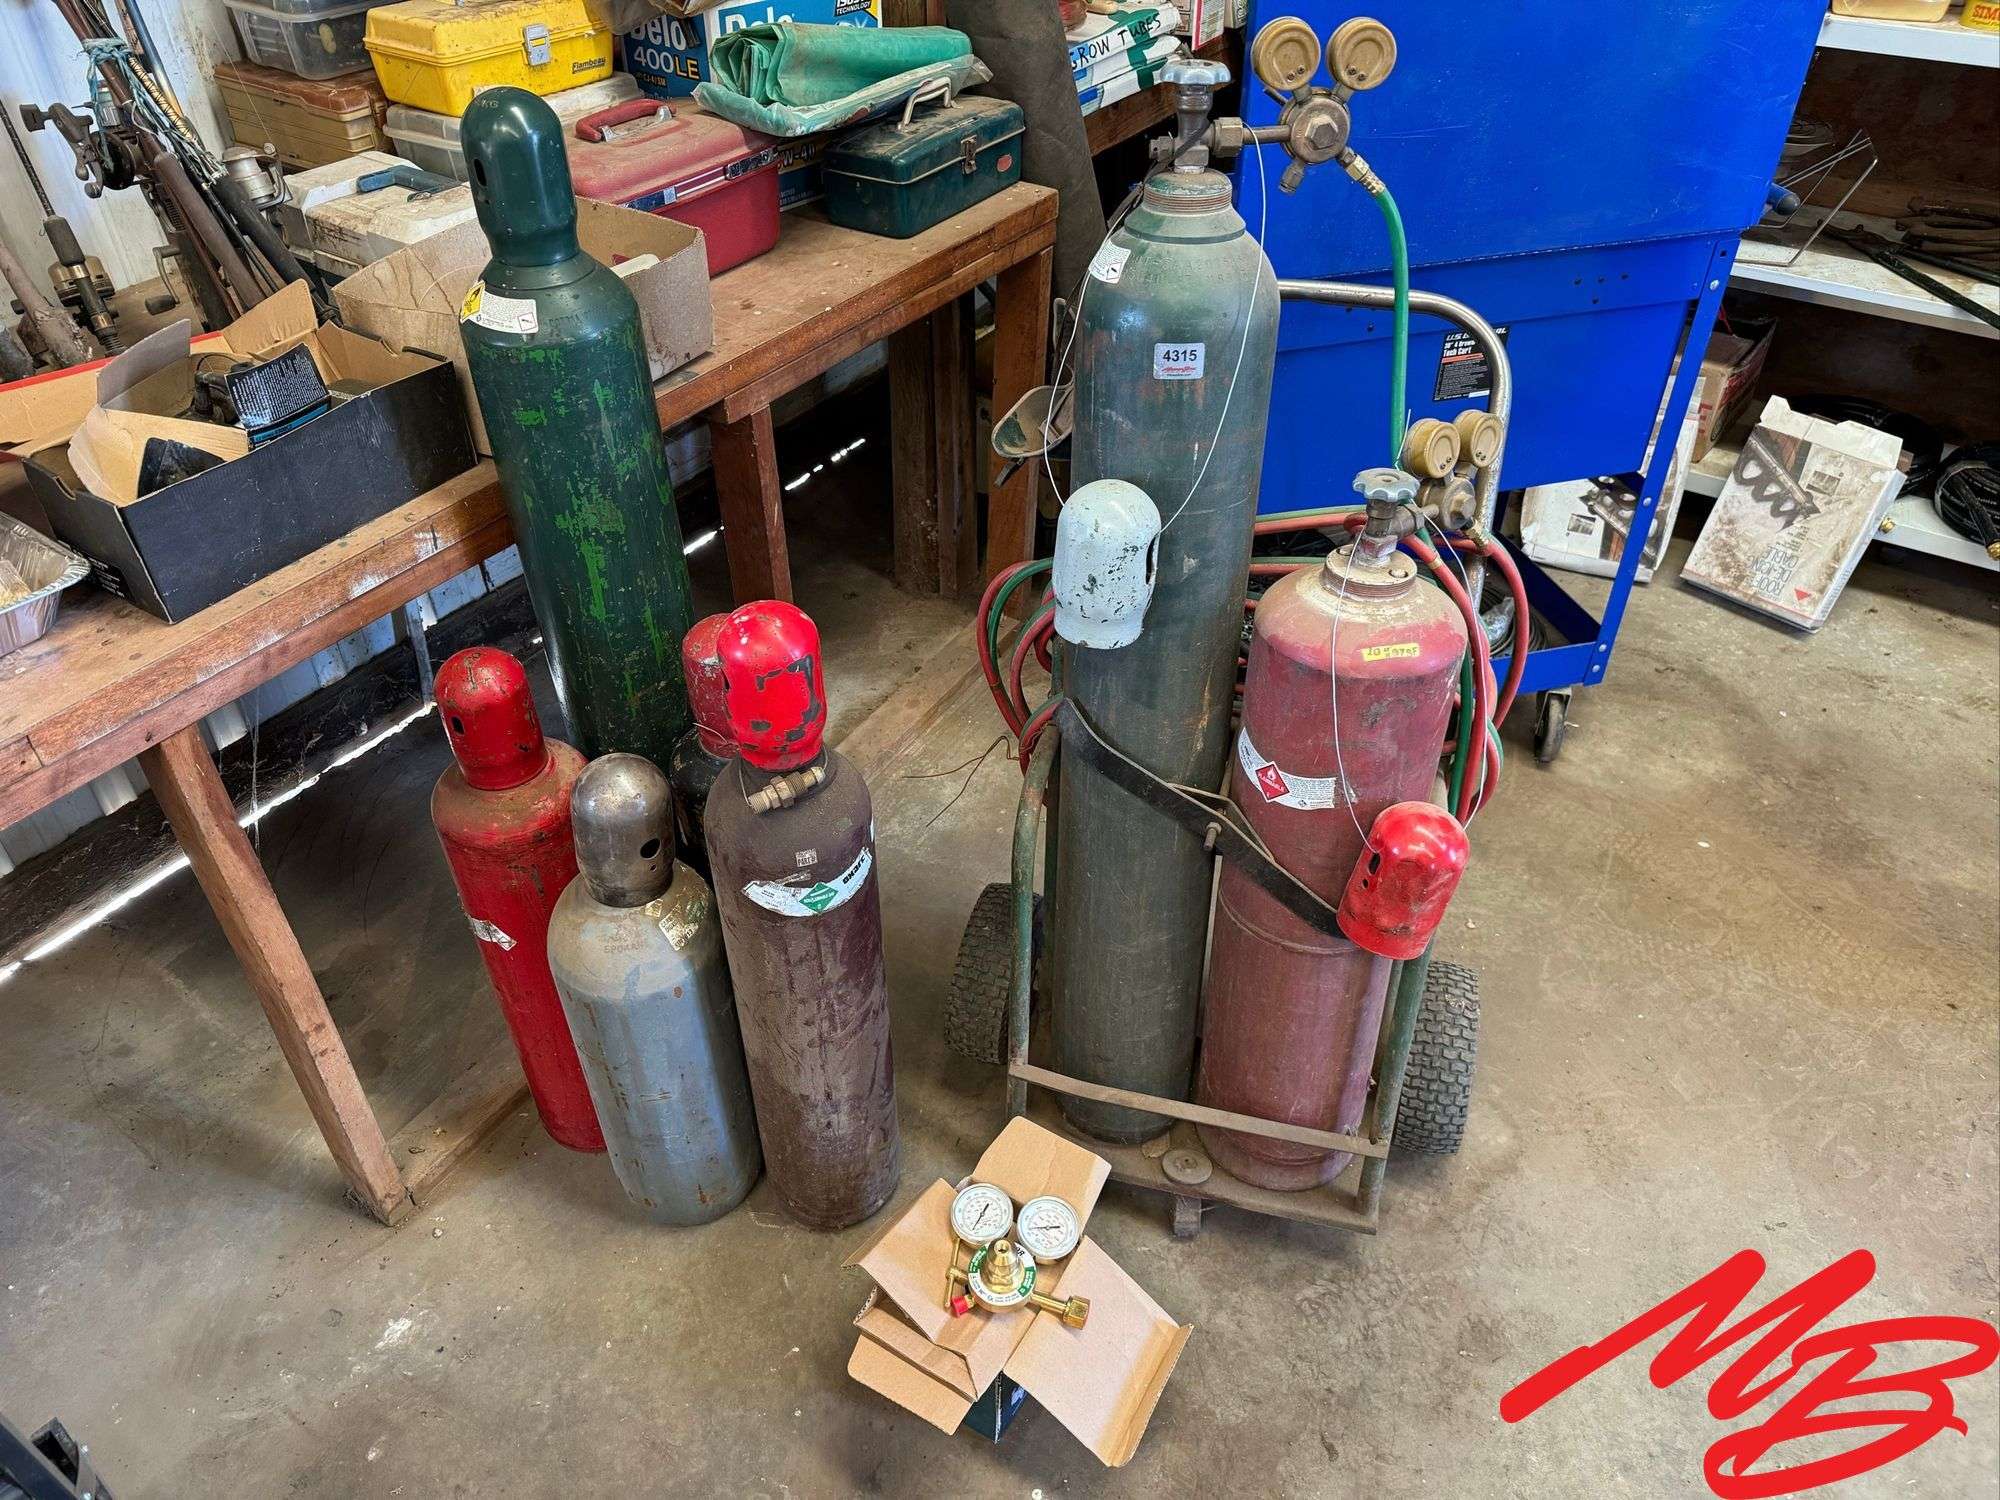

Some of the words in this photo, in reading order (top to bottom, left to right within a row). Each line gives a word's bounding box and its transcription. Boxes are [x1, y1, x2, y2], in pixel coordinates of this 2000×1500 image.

[836, 1, 871, 15] TECHNOLOGY
[572, 57, 606, 74] Flambeau
[634, 46, 699, 80] 400LE
[1162, 349, 1198, 362] 4315
